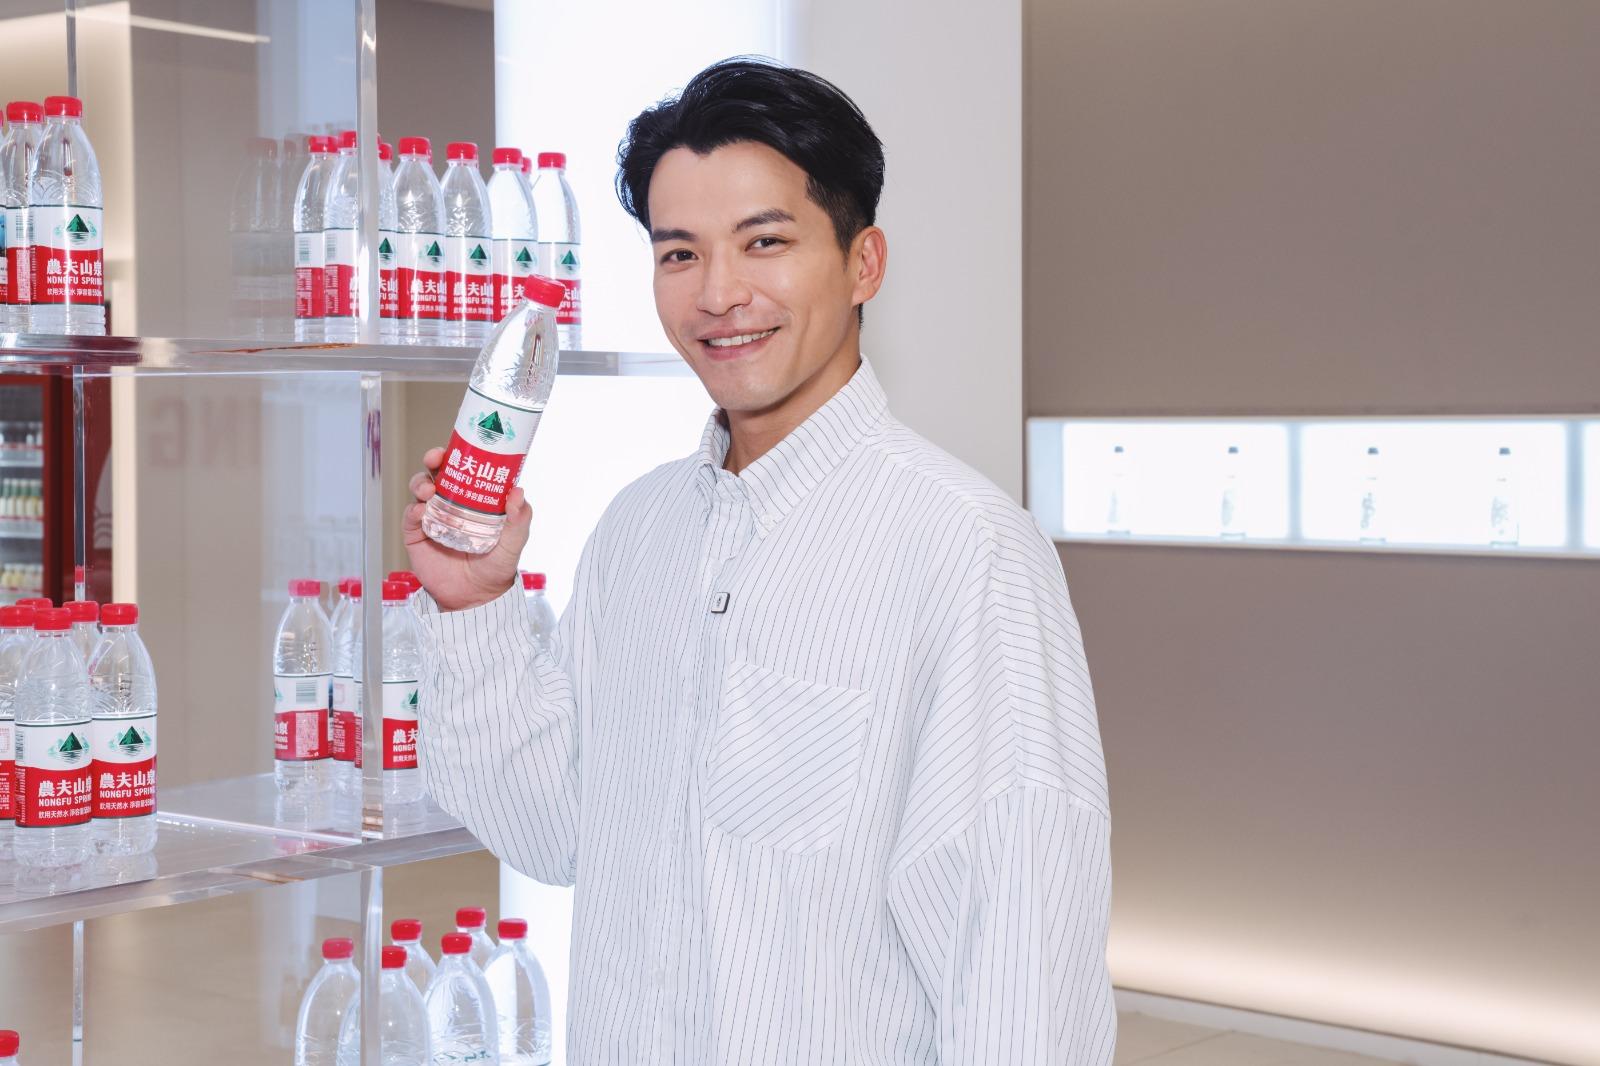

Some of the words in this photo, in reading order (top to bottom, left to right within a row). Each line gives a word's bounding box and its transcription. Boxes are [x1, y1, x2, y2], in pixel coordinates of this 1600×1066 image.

[47, 258, 102, 276] 農夫山泉
[47, 276, 78, 285] NONGFU
[447, 448, 510, 484] 農夫山泉
[444, 465, 473, 485] NONGFU
[474, 479, 505, 494] SPRING
[99, 768, 156, 789] 農夫山泉
[38, 797, 72, 807] NONGFU
[99, 789, 132, 799] NONGFU
